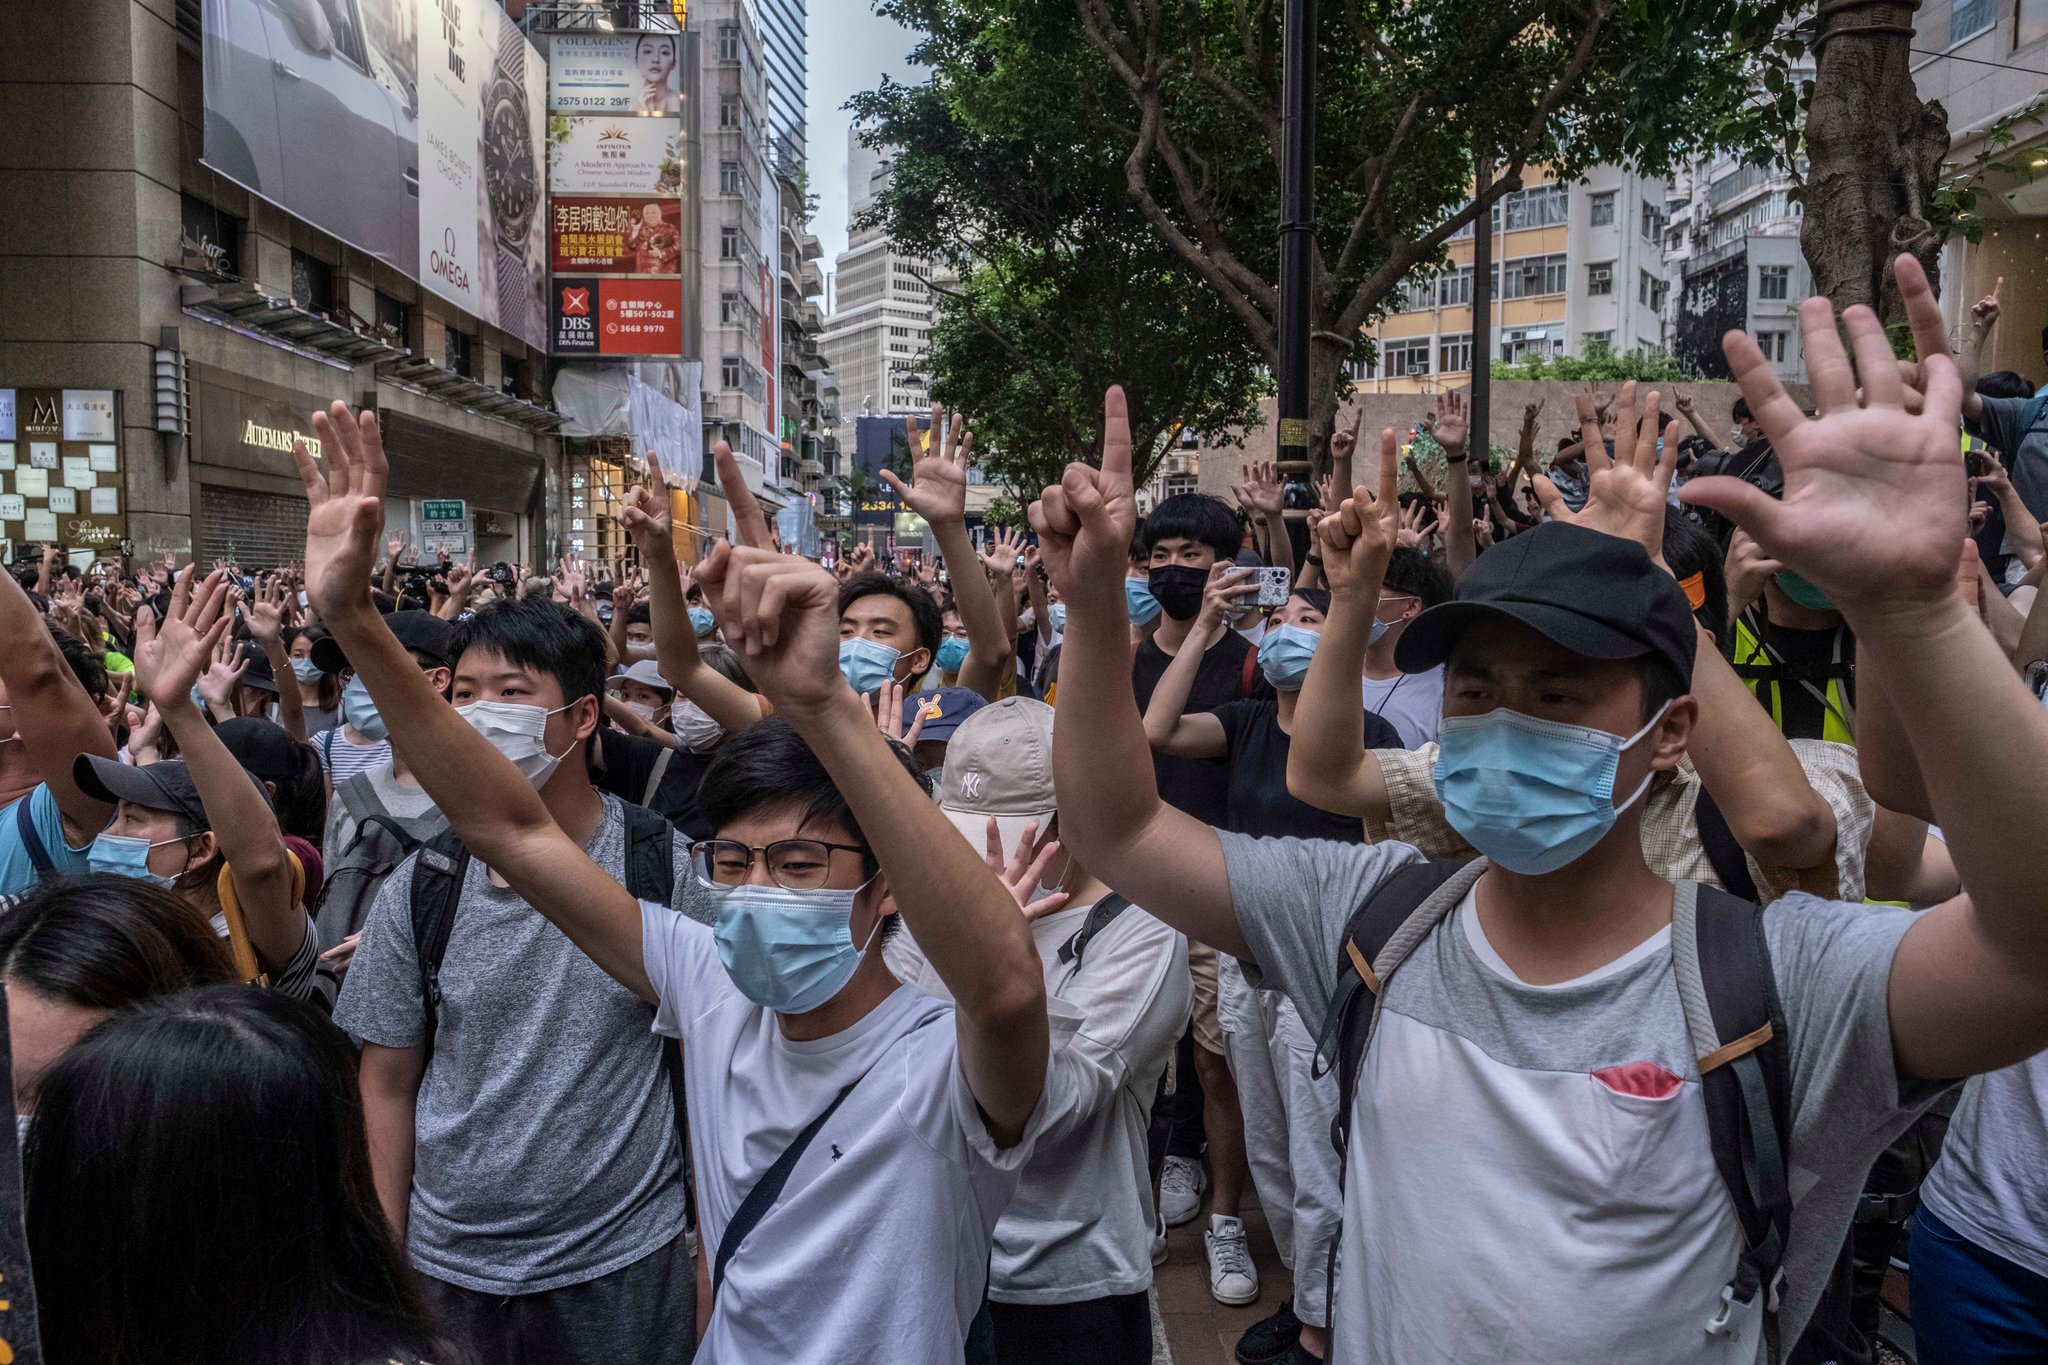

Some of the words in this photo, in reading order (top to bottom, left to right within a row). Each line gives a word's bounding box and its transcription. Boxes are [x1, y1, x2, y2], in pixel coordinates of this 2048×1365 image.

[557, 37, 631, 46] COLLAGEN+
[557, 97, 580, 105] 2575
[583, 97, 606, 105] 0122
[610, 98, 631, 106] 29/F
[613, 162, 646, 170] Approach
[430, 250, 470, 293] OMEGA
[562, 317, 591, 330] DBS
[620, 324, 641, 332] 3668
[643, 324, 664, 332] 9970
[244, 419, 293, 453] AUDEMARS
[430, 510, 457, 518] 的士站
